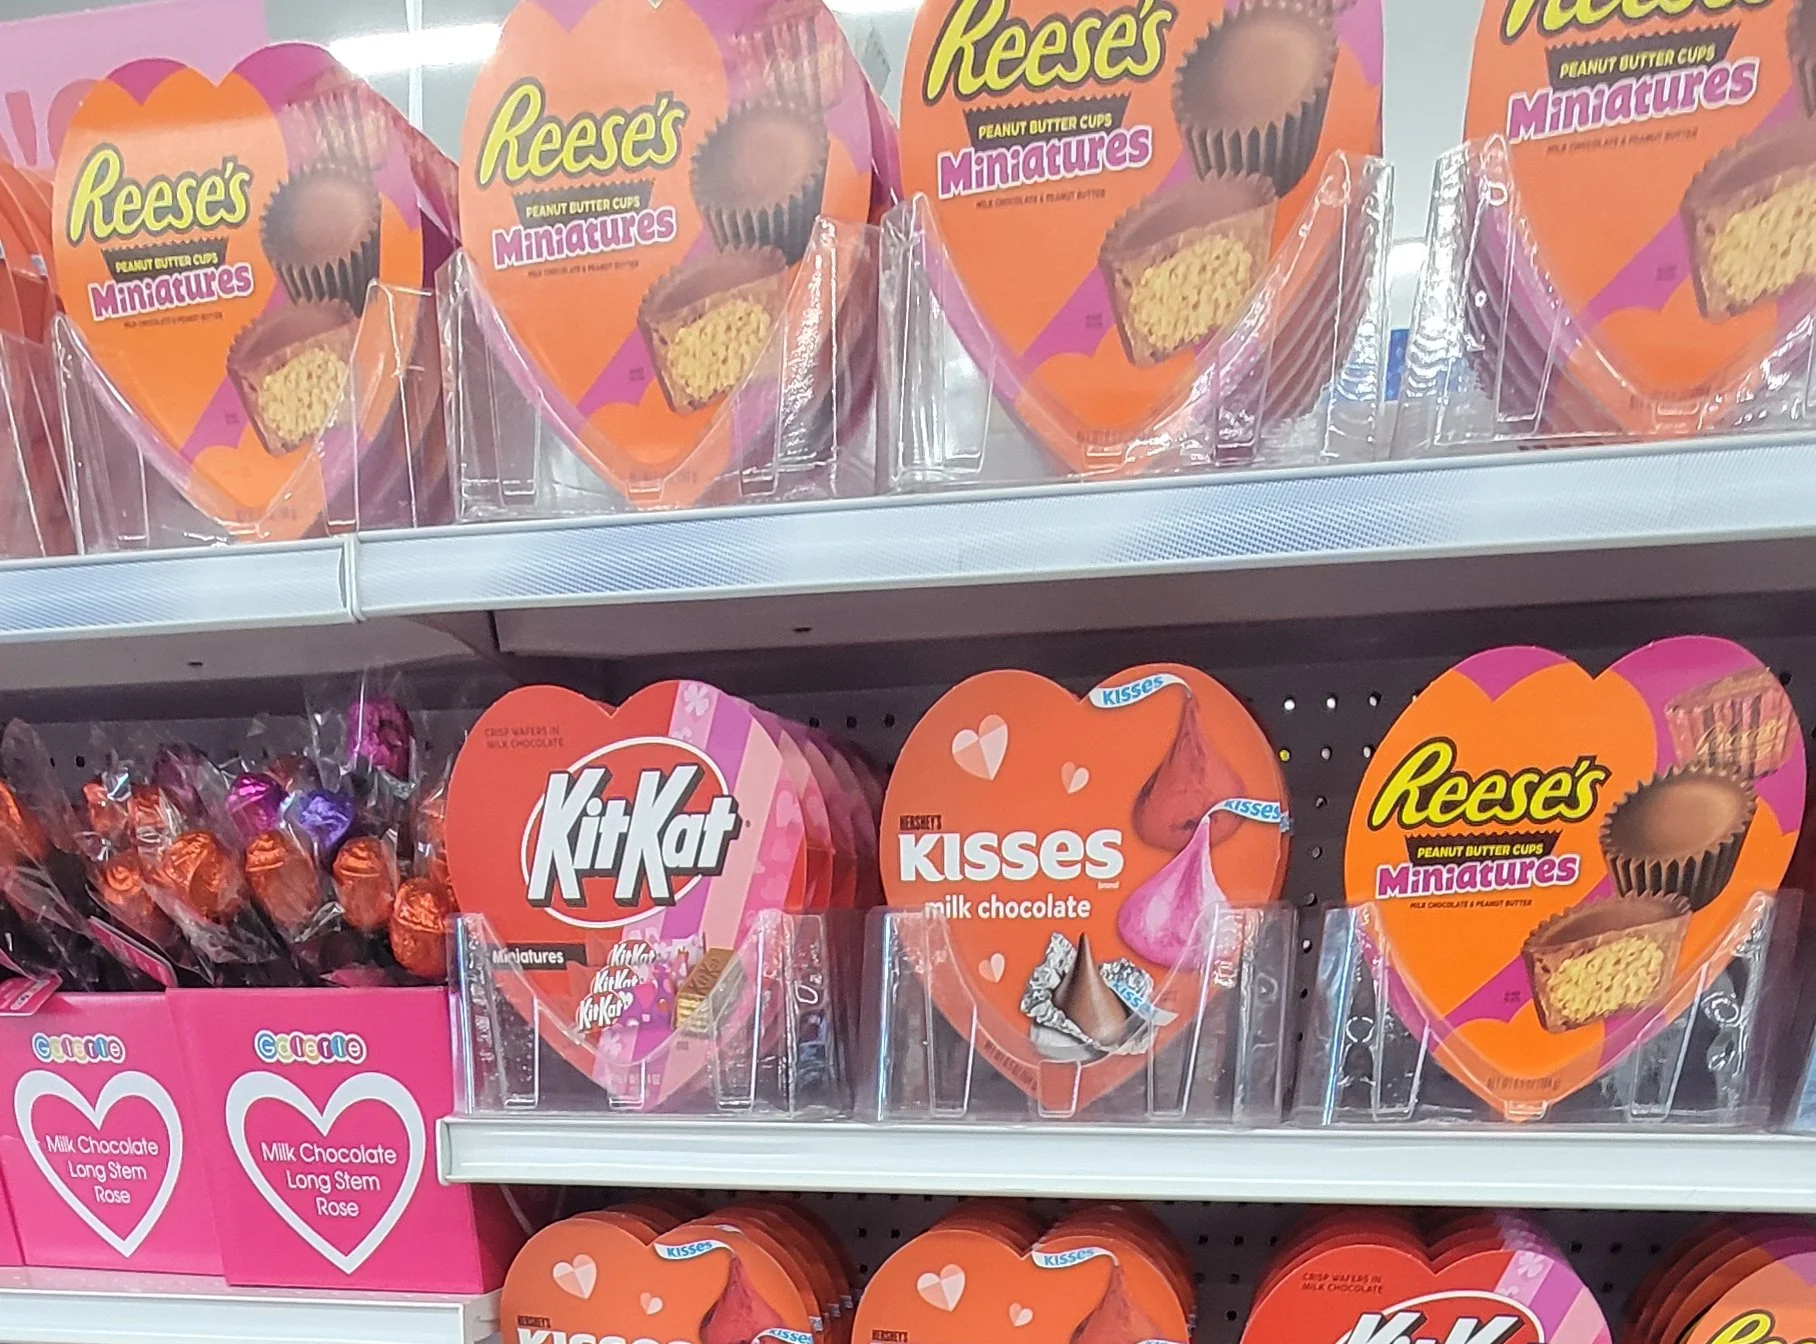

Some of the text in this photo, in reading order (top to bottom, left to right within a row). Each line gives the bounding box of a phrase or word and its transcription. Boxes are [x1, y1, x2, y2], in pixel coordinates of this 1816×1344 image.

[1560, 43, 1715, 79] PEANUT BUTTER CUPS
[1507, 56, 1760, 145] Miniatures
[480, 84, 684, 184] Reese's
[979, 113, 1112, 140] PEANUT BUTTER CUPS
[937, 126, 1152, 200] Miniatures
[69, 147, 251, 243] Reese's
[526, 196, 640, 218] PEANUT BUTTER CUPS
[492, 206, 676, 270] Miniatures
[116, 252, 218, 273] PEANUT BUTTER CUPS
[89, 263, 254, 320] Miniatures
[1372, 741, 1605, 828] Reese's
[526, 765, 742, 907] KitKat
[1417, 842, 1544, 860] PEANUT BUTTER CUPS
[1375, 853, 1579, 900] Miniatures
[925, 893, 1091, 919] milk chocolate
[492, 948, 564, 966] Miniatures
[254, 1030, 367, 1064] Galerie
[46, 1134, 159, 1156] Milk Chocolate
[260, 1142, 397, 1165] Milk Chocolate
[68, 1160, 147, 1181] Long Stem
[286, 1170, 381, 1193] Long Stem
[94, 1186, 131, 1205] Rose
[316, 1197, 359, 1217] Rose
